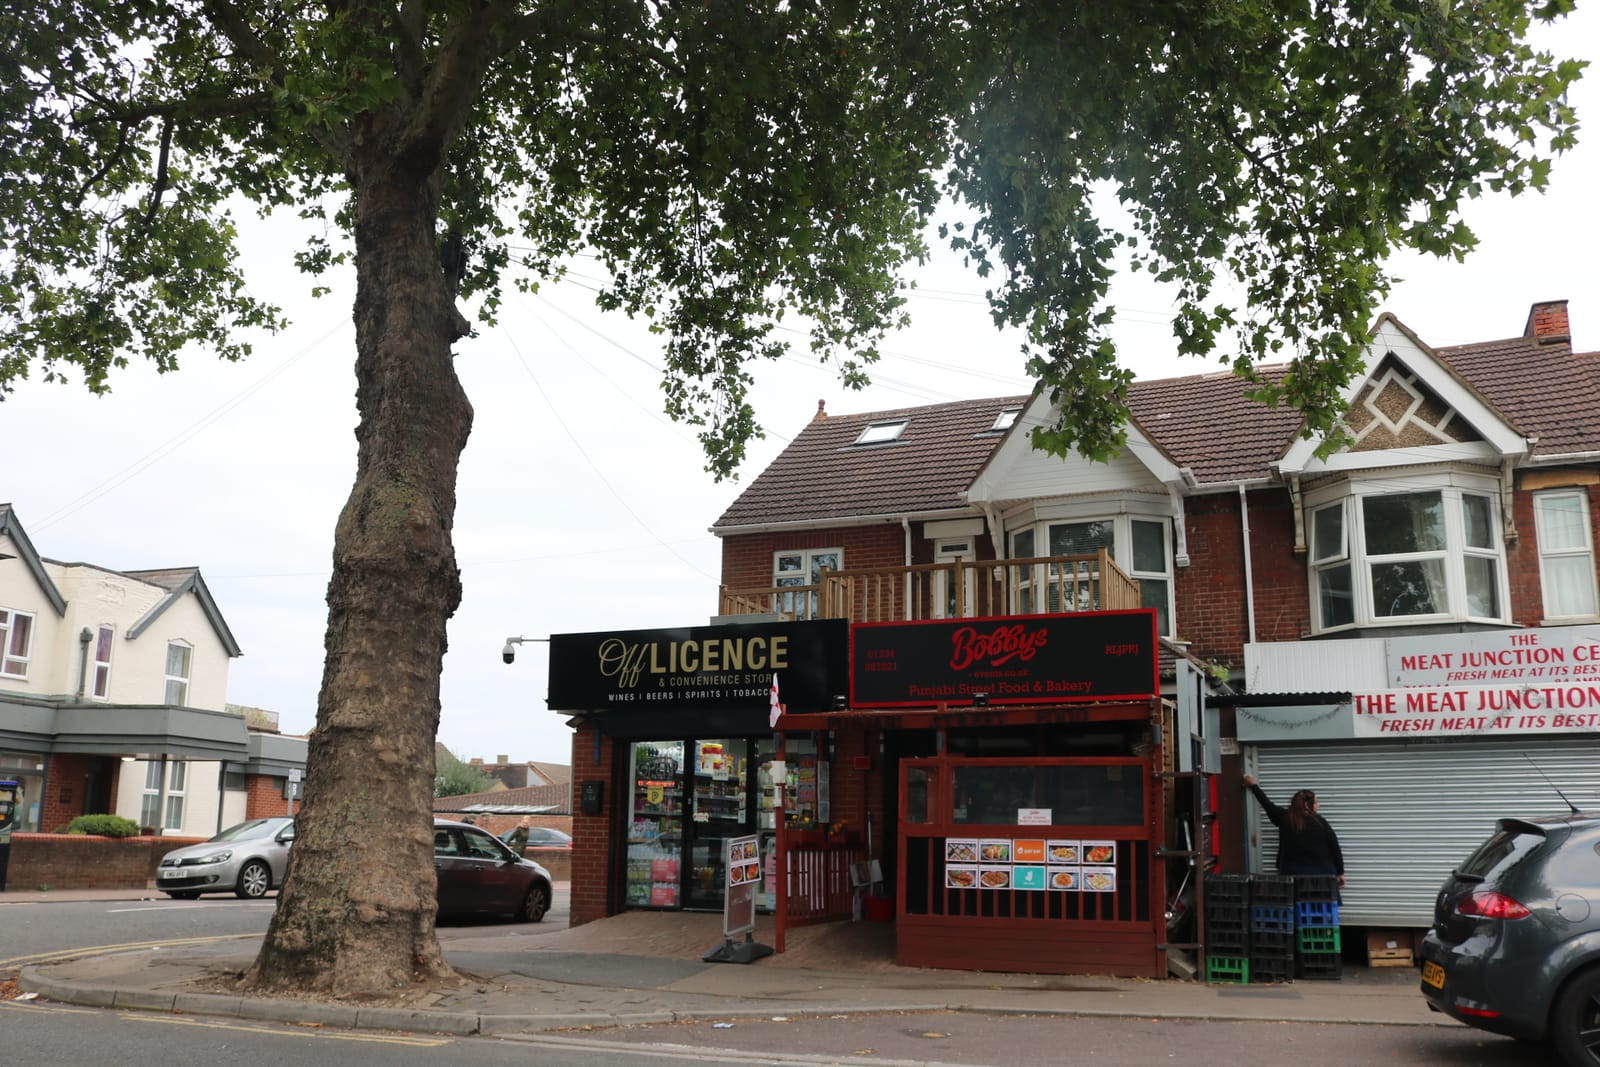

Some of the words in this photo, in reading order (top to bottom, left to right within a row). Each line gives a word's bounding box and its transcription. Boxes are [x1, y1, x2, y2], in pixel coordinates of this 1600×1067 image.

[950, 624, 1049, 671] Bobbys
[1509, 633, 1538, 647] THE
[599, 638, 649, 688] Off
[650, 636, 788, 673] LICENCE
[1401, 653, 1454, 671] MEAT
[1460, 648, 1565, 668] JUNCTION
[658, 677, 665, 687] &
[670, 674, 740, 687] CONVENIENCE
[1447, 670, 1487, 681] FRESH
[1490, 668, 1526, 679] MEAT
[1529, 667, 1545, 677] AT
[1549, 666, 1569, 676] ITS
[1573, 664, 1600, 675] BES
[608, 693, 635, 701] WINES
[646, 691, 674, 700] BEERS
[685, 690, 721, 699] SPIRITS
[908, 683, 955, 698] Punjabi
[959, 682, 996, 695] Street
[999, 681, 1030, 694] Food
[1034, 680, 1043, 692] &
[1046, 679, 1093, 693] Bakery
[1353, 694, 1397, 715] THE
[1406, 691, 1469, 713] MEAT
[1477, 687, 1600, 711] JUNCTION
[1380, 718, 1435, 732] FRESH
[1439, 717, 1488, 730] MEAT
[1490, 716, 1514, 729] AT
[1518, 715, 1547, 728] ITS
